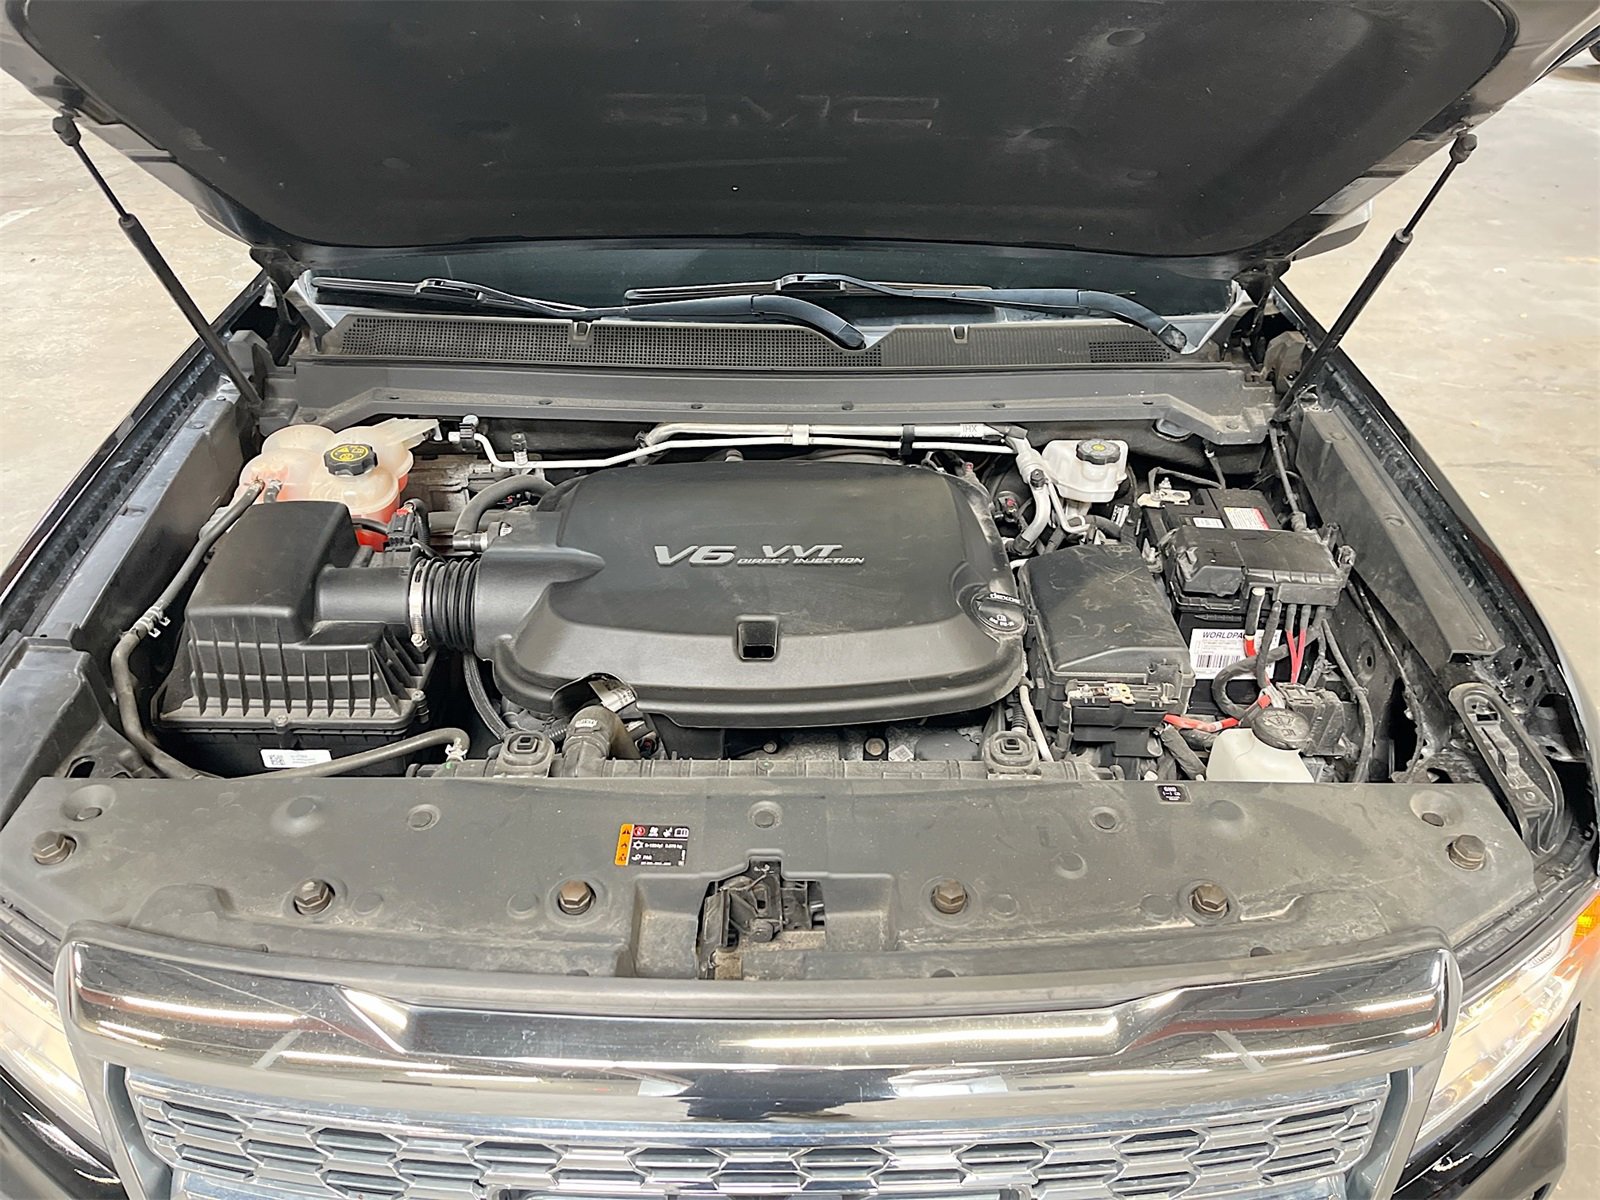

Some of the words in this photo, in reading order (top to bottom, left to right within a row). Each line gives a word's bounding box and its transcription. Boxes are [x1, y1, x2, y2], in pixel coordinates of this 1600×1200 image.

[654, 545, 737, 567] V6
[762, 545, 843, 558] VVT
[793, 557, 865, 565] INJECTION
[1202, 631, 1246, 640] WORLDPA
